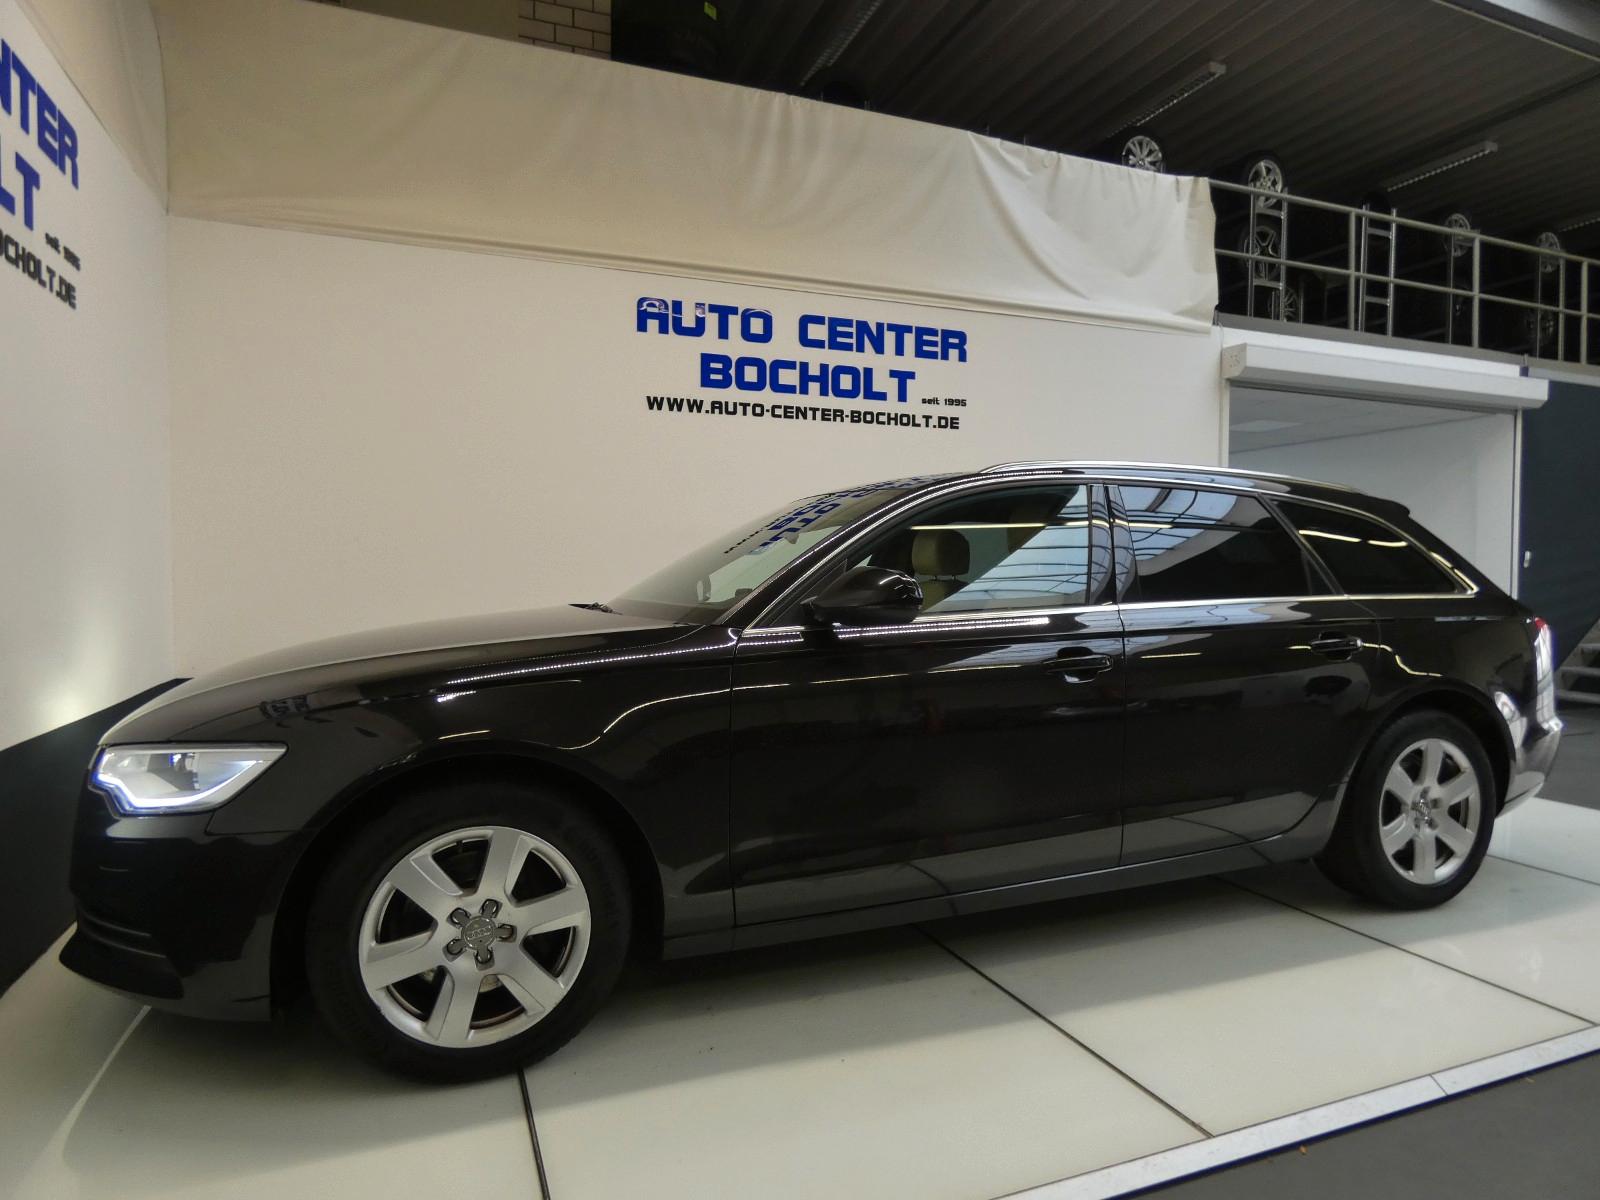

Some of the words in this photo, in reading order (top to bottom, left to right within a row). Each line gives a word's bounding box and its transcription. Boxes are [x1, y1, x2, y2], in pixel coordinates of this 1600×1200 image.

[636, 296, 773, 344] AUTO
[798, 313, 968, 363] CENTER
[699, 352, 916, 403] BOCHOLT
[645, 395, 960, 430] WWW.AUTO-CENTER-BOCHOLT.DE
[921, 396, 941, 406] seit
[943, 398, 967, 407] 1995
